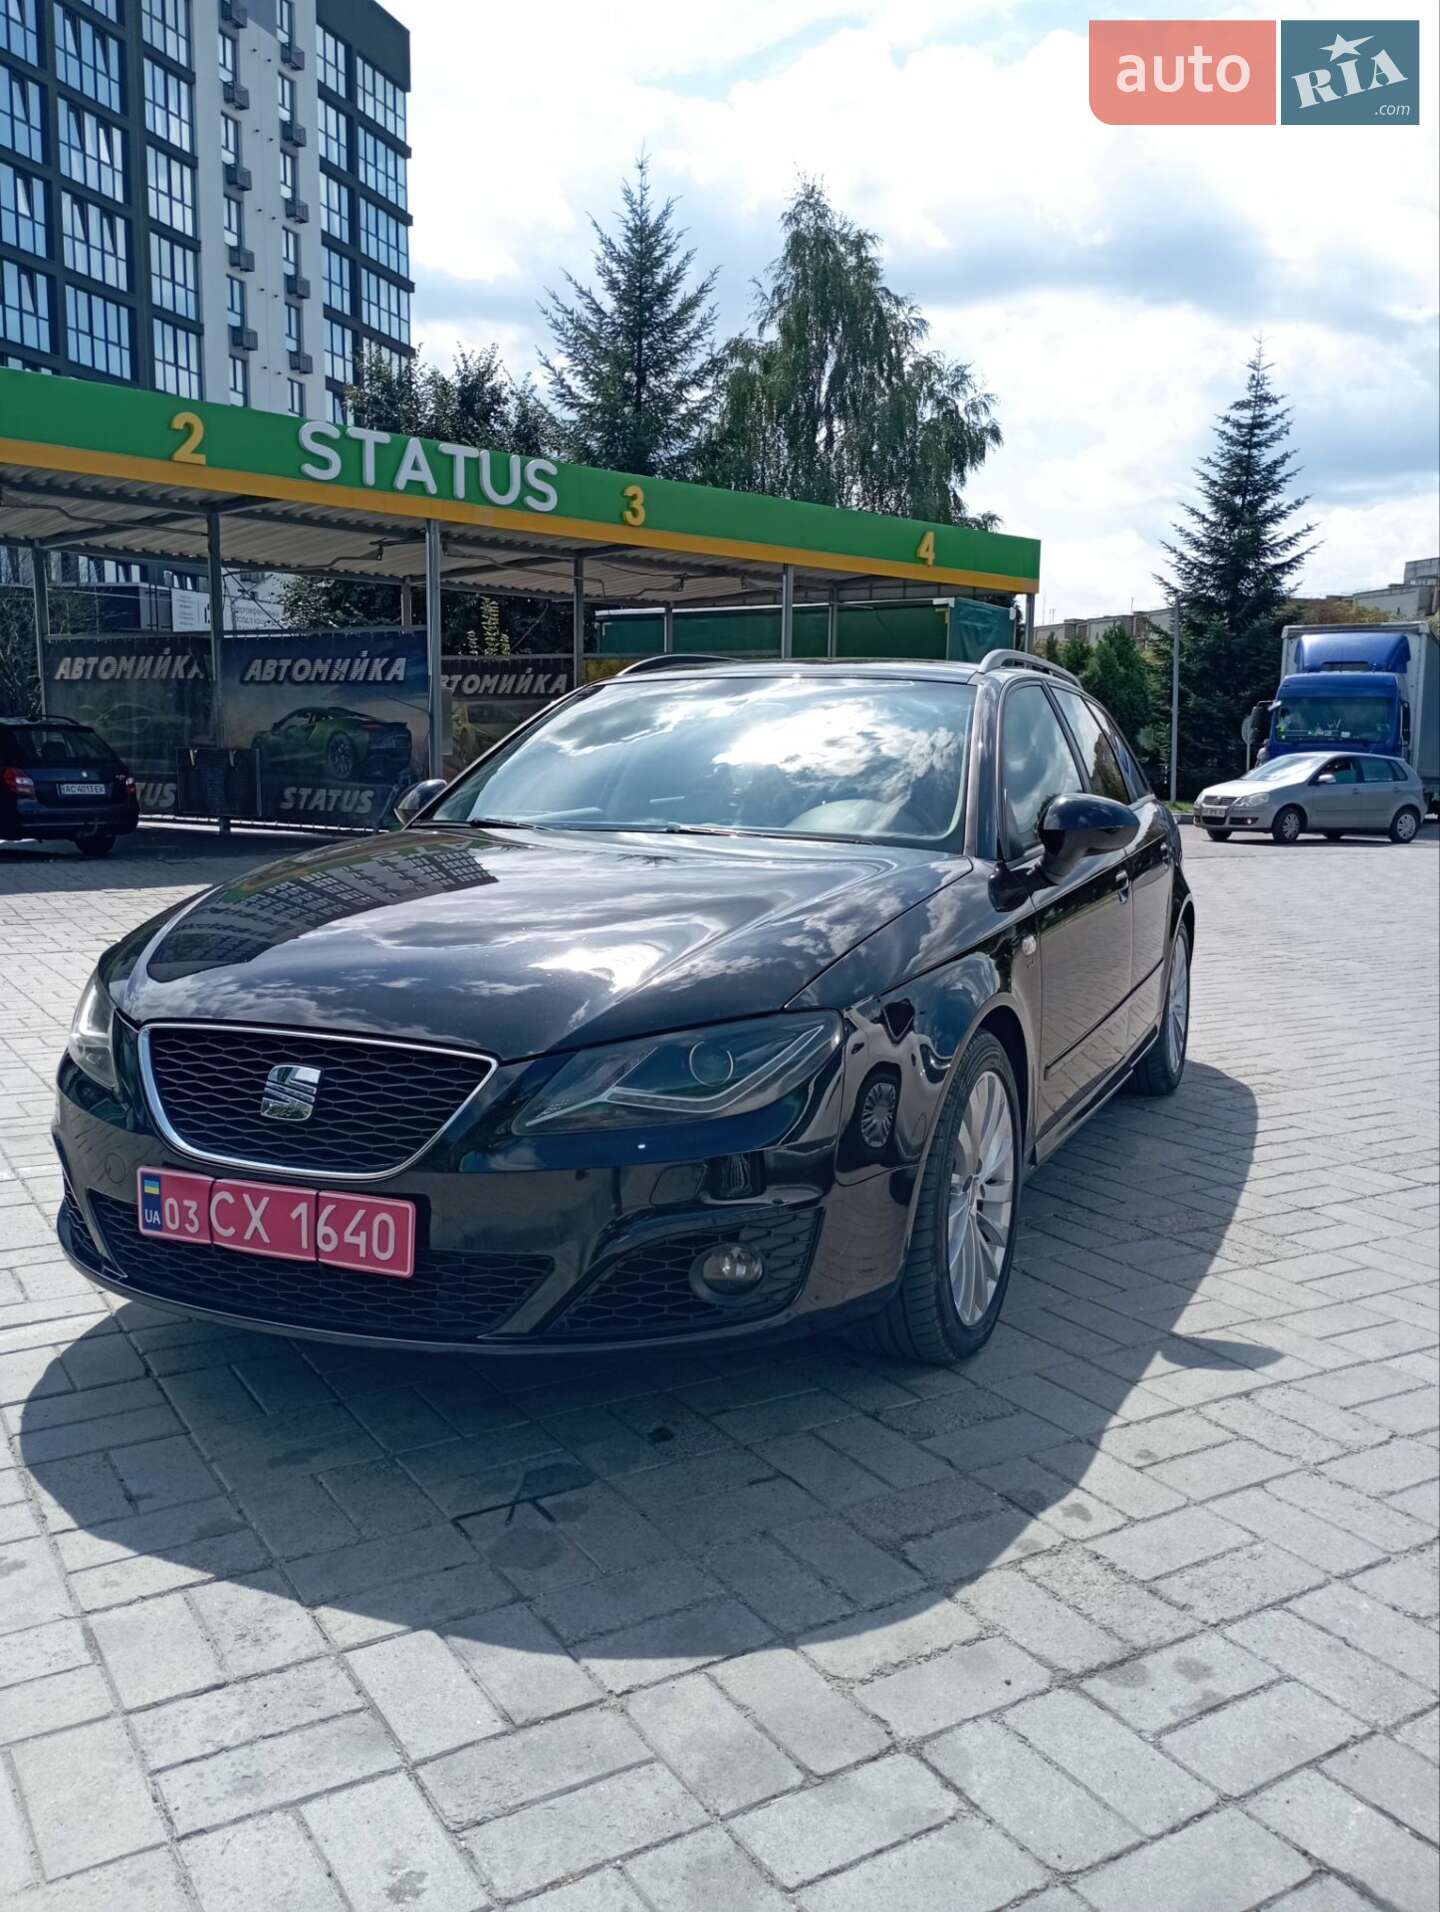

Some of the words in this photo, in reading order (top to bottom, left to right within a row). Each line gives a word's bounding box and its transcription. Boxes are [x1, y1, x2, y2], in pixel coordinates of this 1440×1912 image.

[170, 411, 206, 465] 2
[299, 420, 558, 512] STATUS
[624, 485, 646, 526] 3
[917, 530, 936, 567] 4
[243, 650, 407, 682] АВТОМИЙКА
[440, 667, 568, 694] ТОМИЙКА
[135, 782, 177, 808] TUS
[280, 786, 376, 814] STATUS
[145, 1209, 161, 1225] UA
[290, 1202, 396, 1261] 1640
